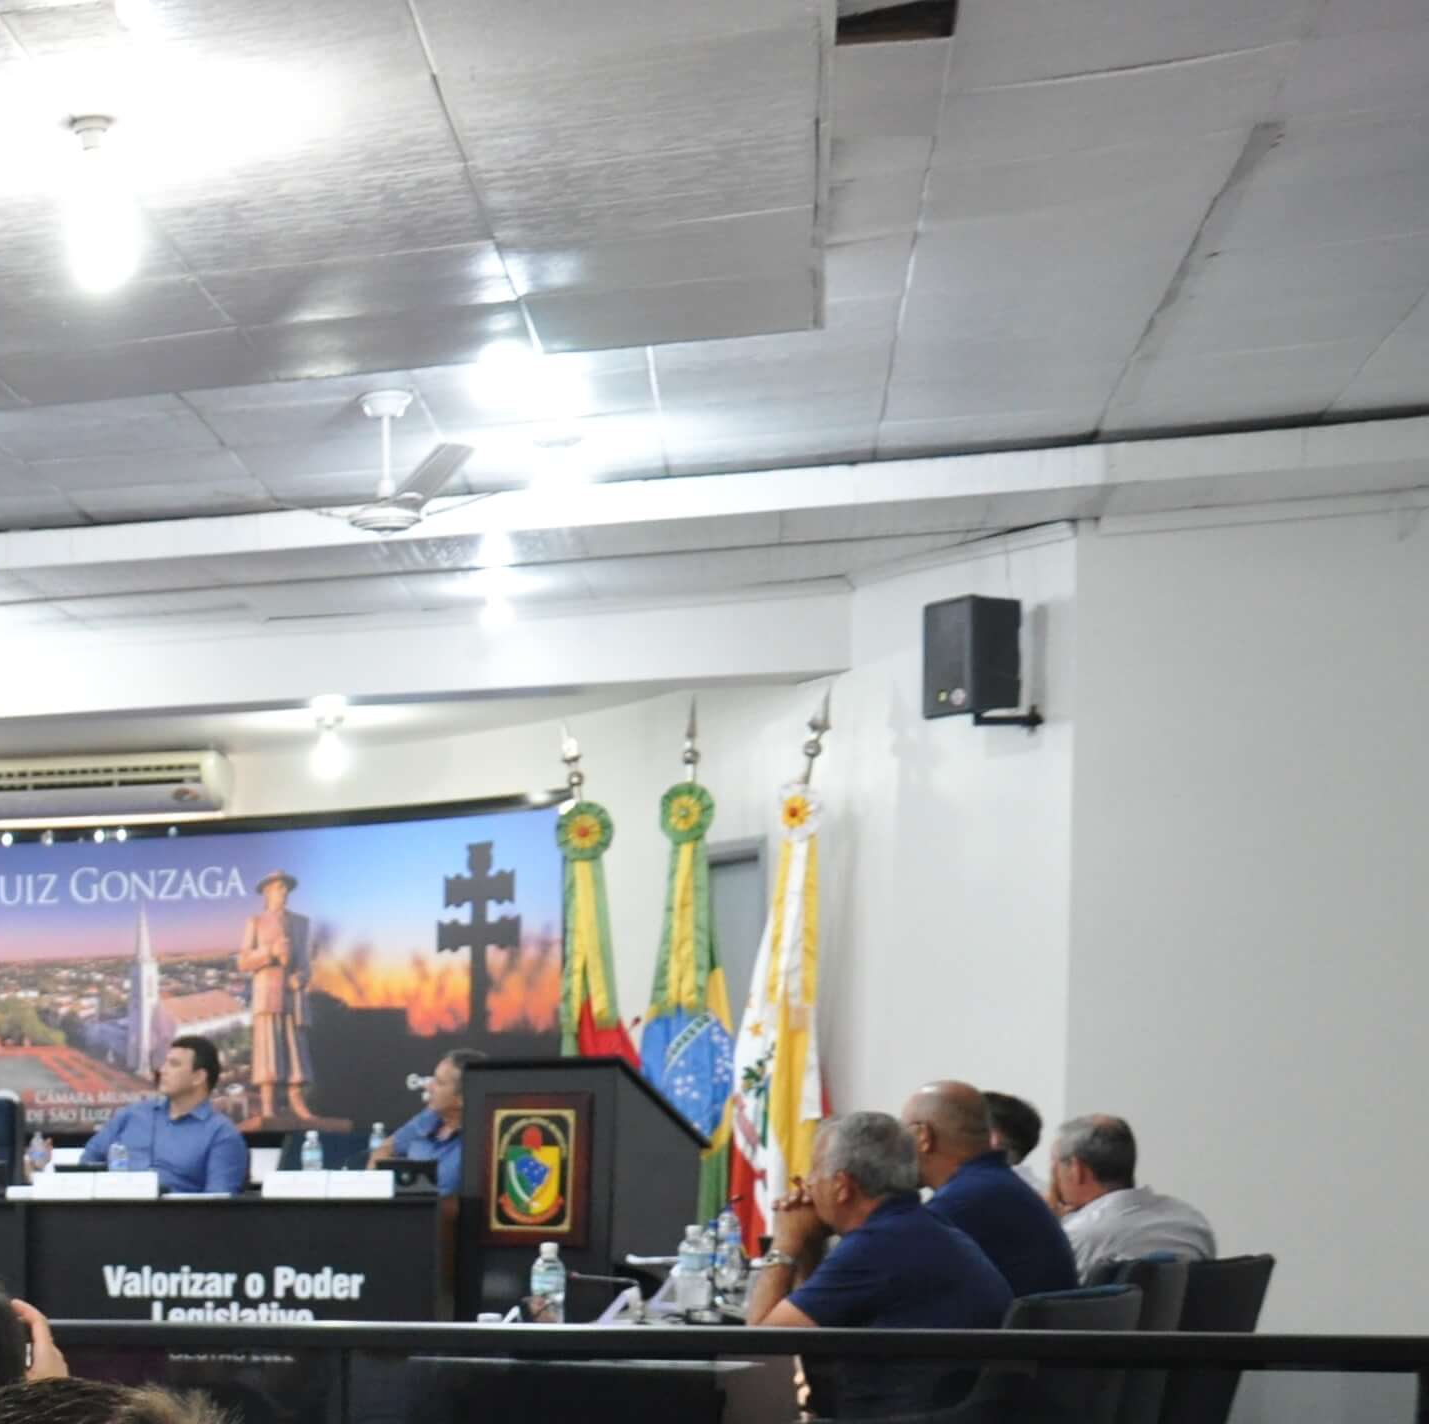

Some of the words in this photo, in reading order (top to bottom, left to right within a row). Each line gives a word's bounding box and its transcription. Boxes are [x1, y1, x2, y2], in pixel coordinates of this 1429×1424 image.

[69, 866, 246, 904] GONZAGA
[103, 1265, 237, 1299] Valorizar
[244, 1270, 266, 1300] o
[273, 1266, 365, 1300] Poder
